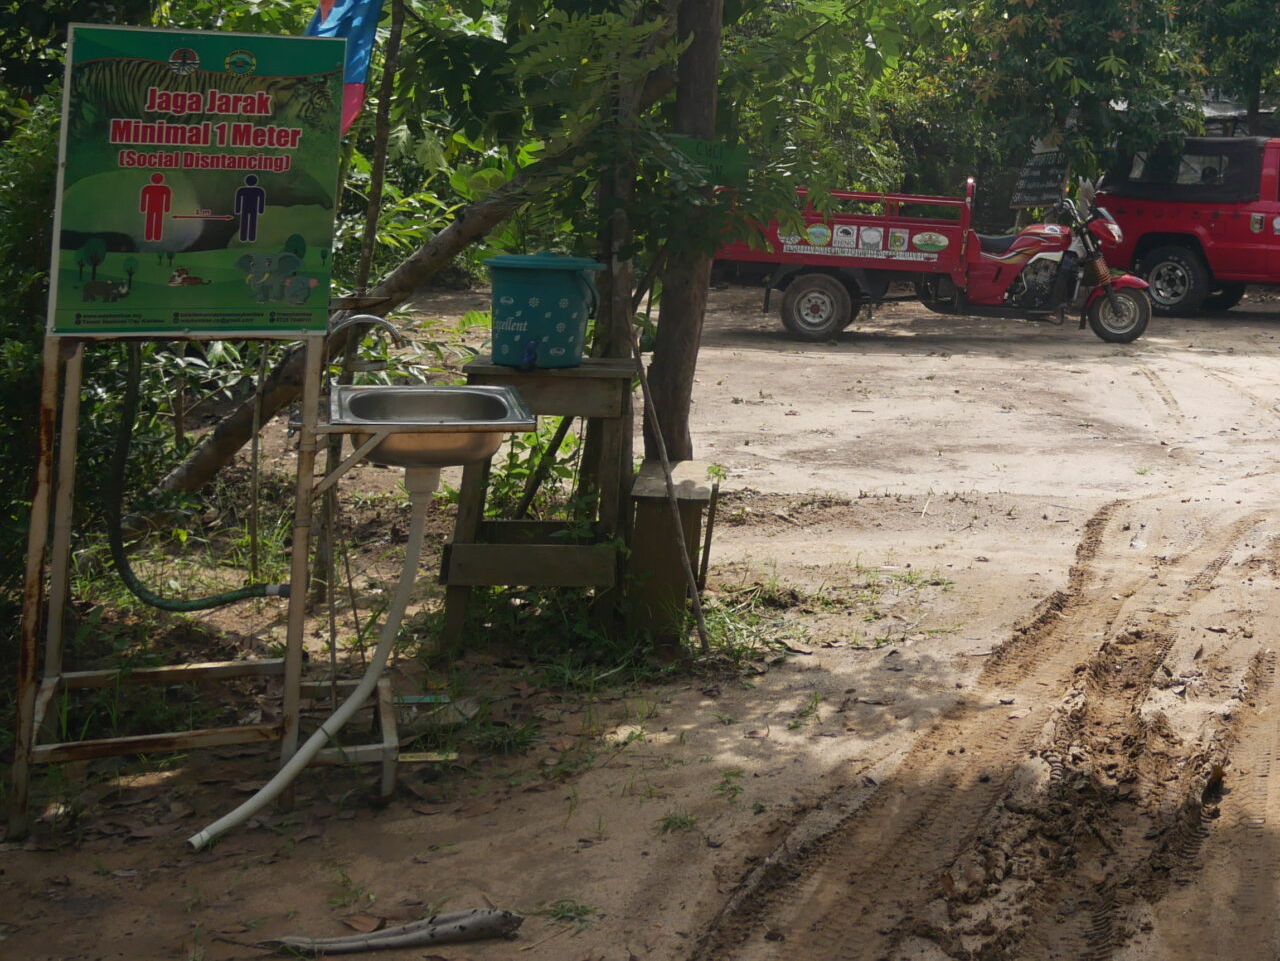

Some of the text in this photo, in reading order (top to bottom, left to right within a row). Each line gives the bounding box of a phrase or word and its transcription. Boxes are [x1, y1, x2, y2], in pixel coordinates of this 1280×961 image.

[145, 87, 272, 115] Jaga Jarak
[110, 118, 302, 149] Minimal 1 Meter
[118, 150, 292, 173] (Social Disntancing)
[834, 239, 855, 247] RHINO
